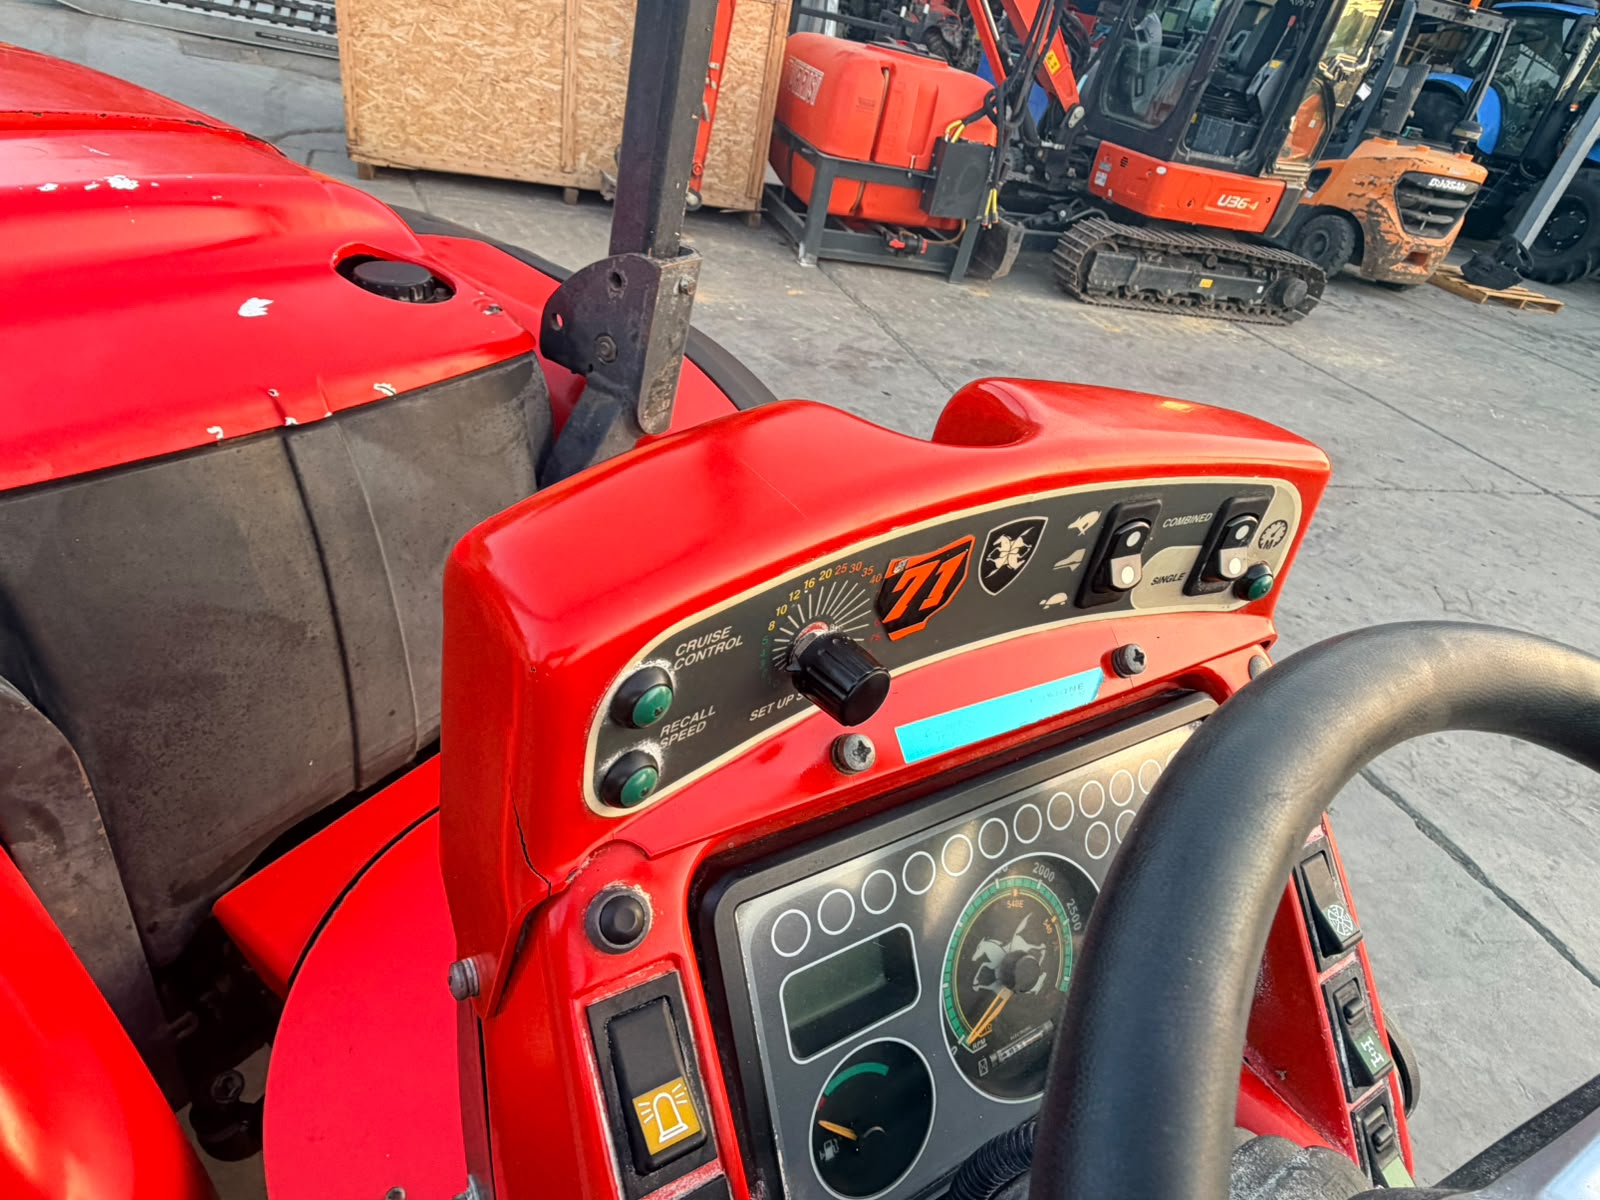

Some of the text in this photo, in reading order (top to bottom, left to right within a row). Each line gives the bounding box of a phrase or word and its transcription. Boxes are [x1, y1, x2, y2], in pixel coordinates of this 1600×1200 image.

[1162, 512, 1213, 529] COMBINED
[881, 550, 969, 625] 71
[1150, 572, 1186, 586] SINGLE
[767, 620, 776, 632] 8
[775, 604, 788, 617] 10
[788, 589, 801, 602] 12
[803, 577, 816, 590] 16
[818, 568, 833, 582] 20
[834, 562, 848, 577] 25
[848, 560, 863, 574] 30
[861, 565, 875, 578] 35
[869, 573, 883, 585] 40
[673, 635, 744, 671] CONTROL
[675, 626, 732, 657] CRUISE
[660, 705, 717, 738] RECALL
[749, 702, 776, 722] SET
[776, 694, 795, 709] UP
[659, 720, 707, 750] SPEED
[1032, 862, 1056, 882] 2000
[1066, 898, 1083, 931] 2500
